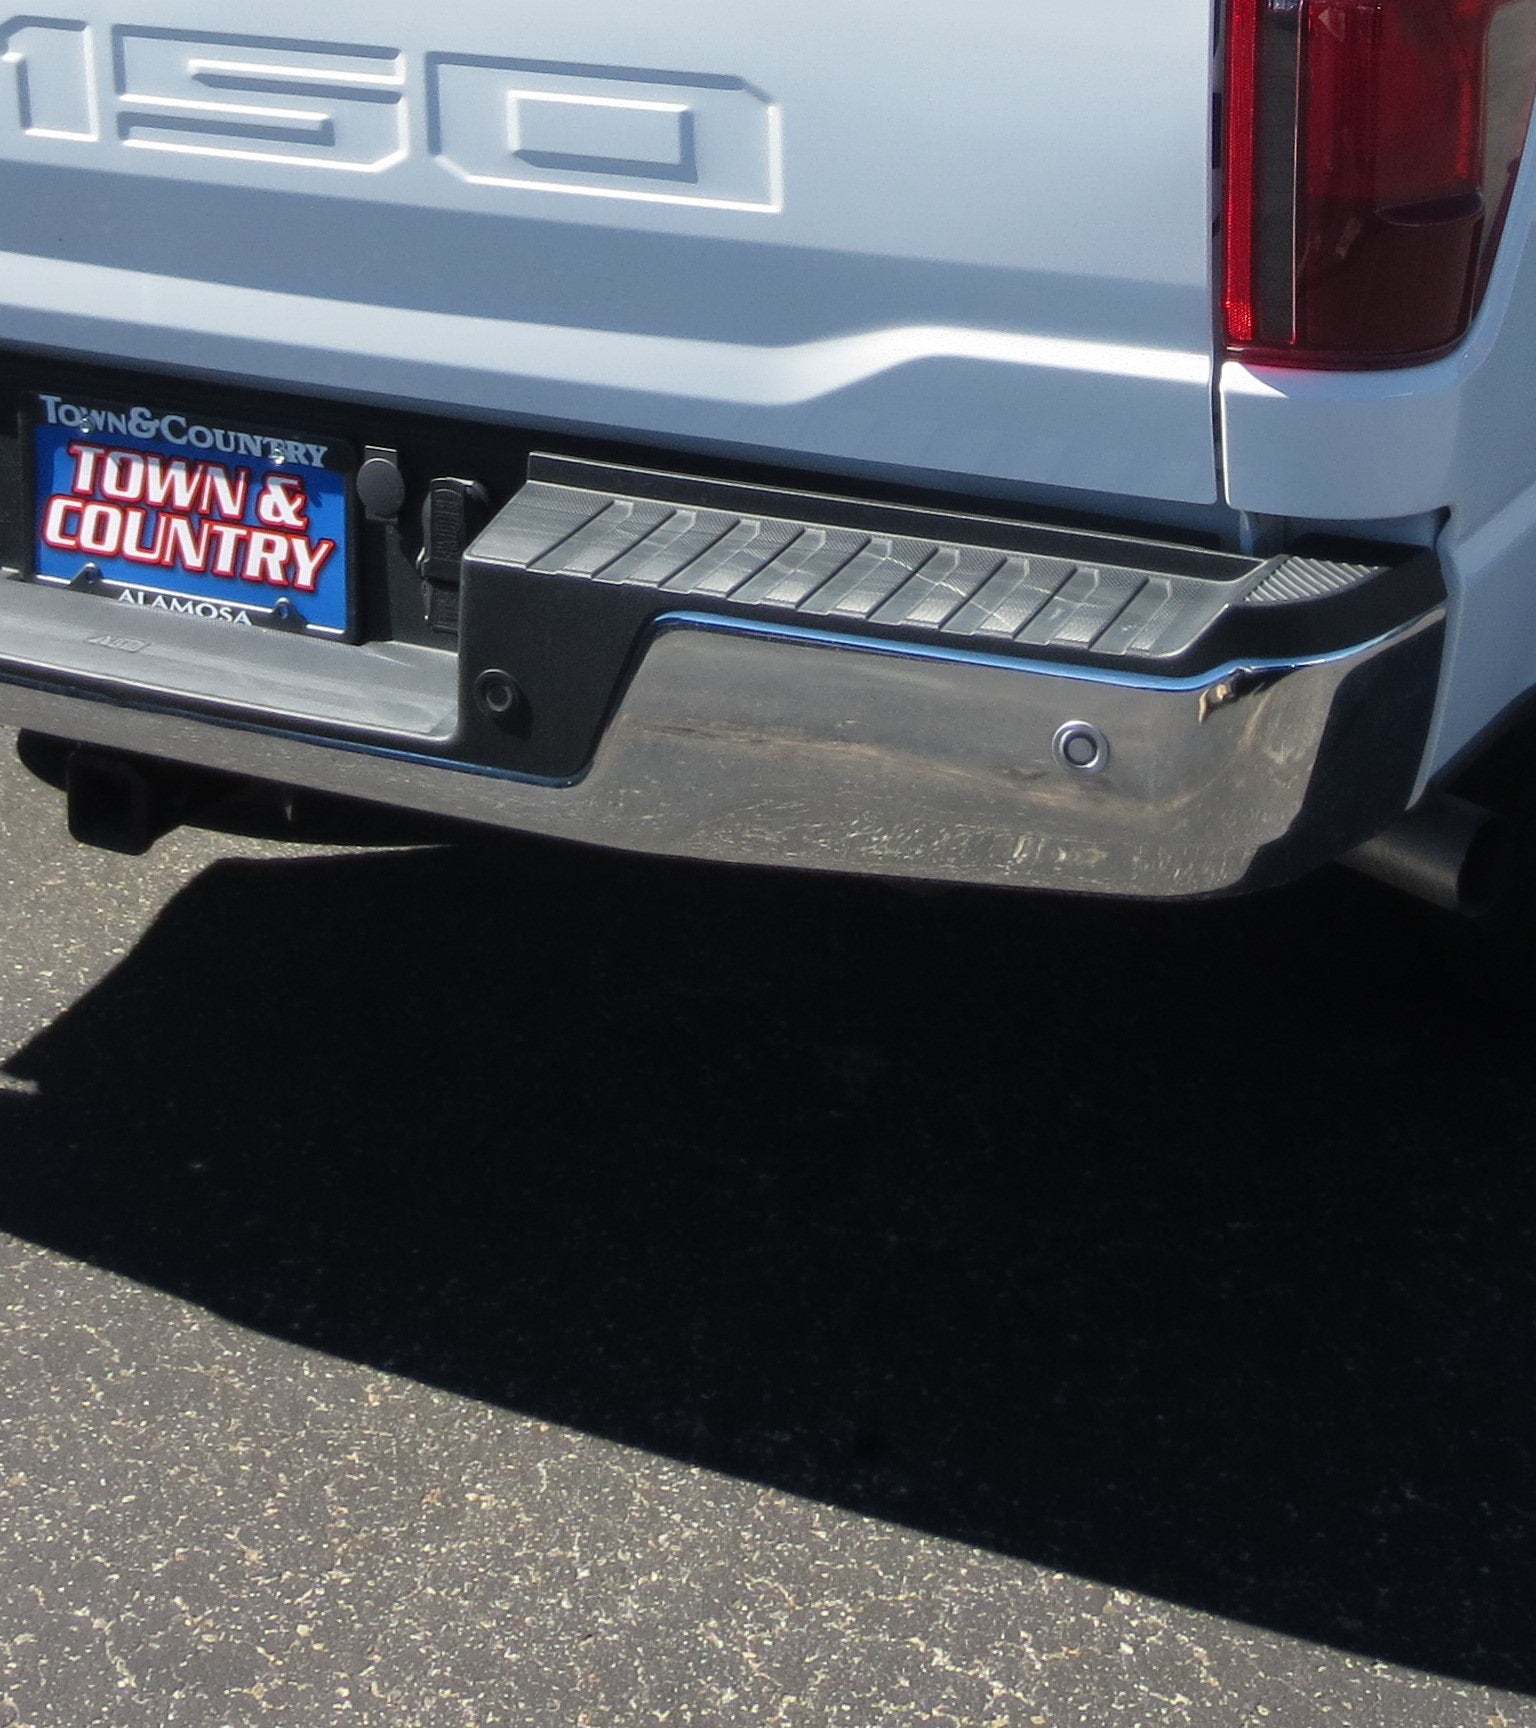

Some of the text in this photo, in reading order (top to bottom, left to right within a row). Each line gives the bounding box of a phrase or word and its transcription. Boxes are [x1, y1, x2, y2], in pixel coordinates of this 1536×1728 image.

[68, 441, 309, 530] TOWN &
[43, 495, 335, 591] COUNTRY
[117, 588, 253, 626] ALAMOSA
